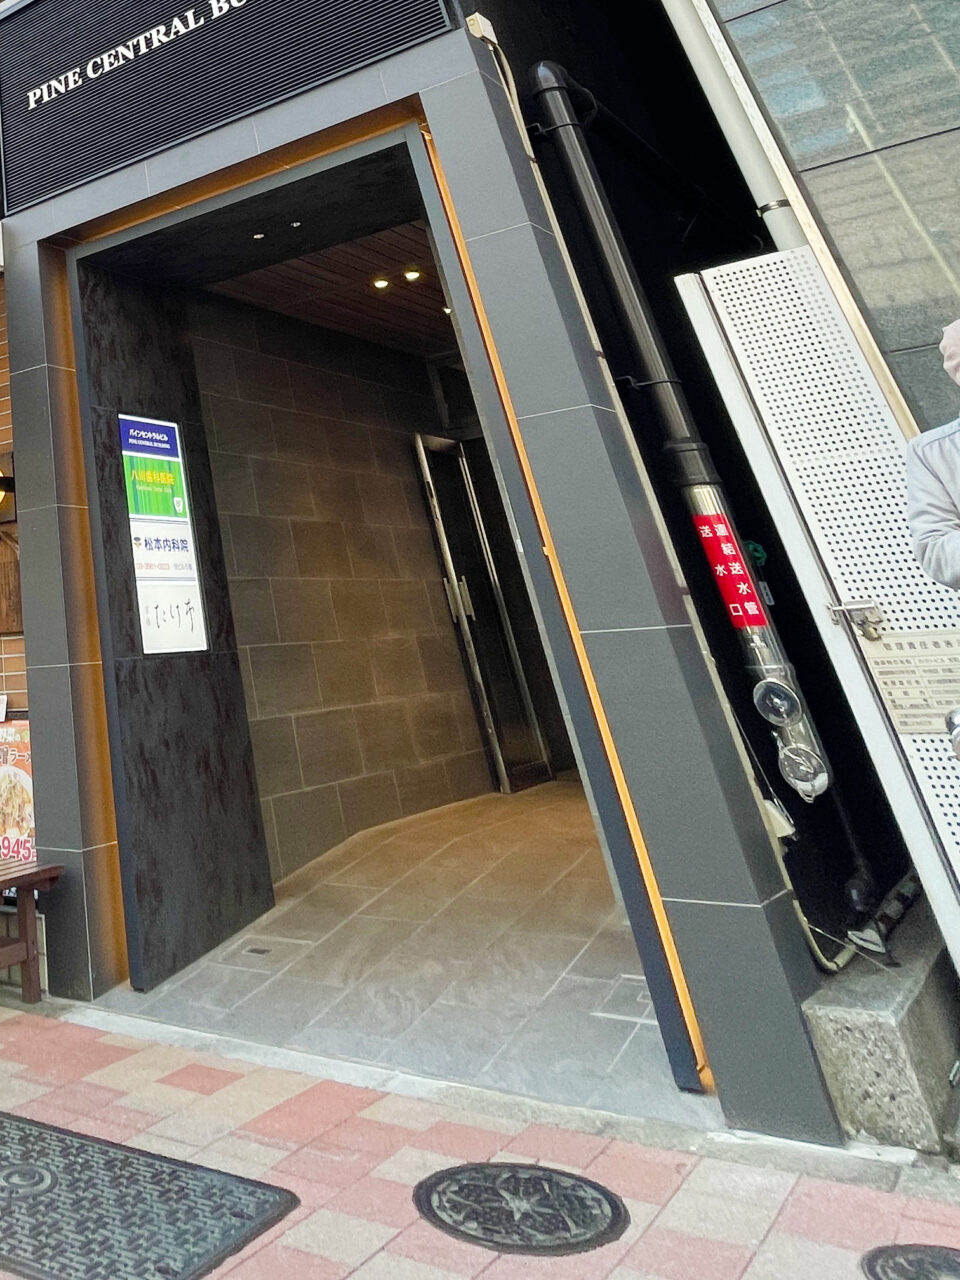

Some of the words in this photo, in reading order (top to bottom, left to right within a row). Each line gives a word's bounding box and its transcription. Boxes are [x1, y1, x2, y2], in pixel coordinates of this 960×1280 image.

[26, 67, 83, 110] PINE
[86, 8, 205, 80] CENTRAL
[144, 537, 190, 552] 松本内科院
[699, 525, 743, 616] 送水口
[713, 524, 759, 615] 連結送水管
